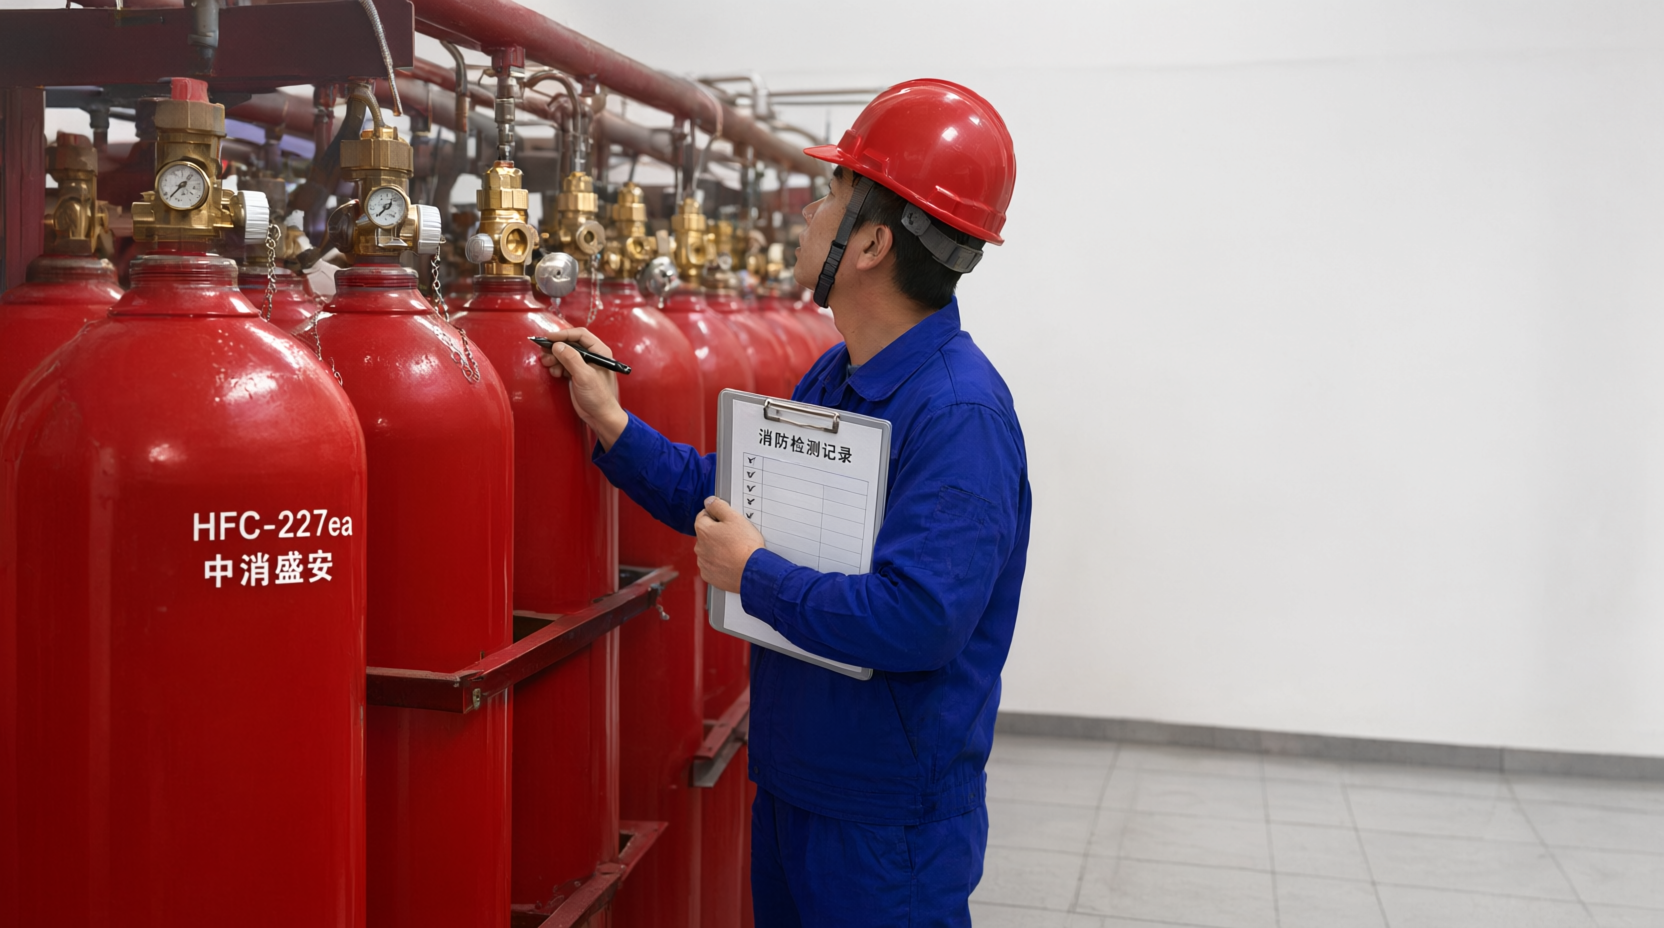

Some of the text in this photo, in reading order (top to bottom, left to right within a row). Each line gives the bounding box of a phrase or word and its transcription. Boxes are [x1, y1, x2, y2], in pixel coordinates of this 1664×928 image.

[759, 428, 853, 464] 消防检测记录
[193, 509, 353, 541] HFC-227ea
[204, 549, 333, 588] 中消盛安
